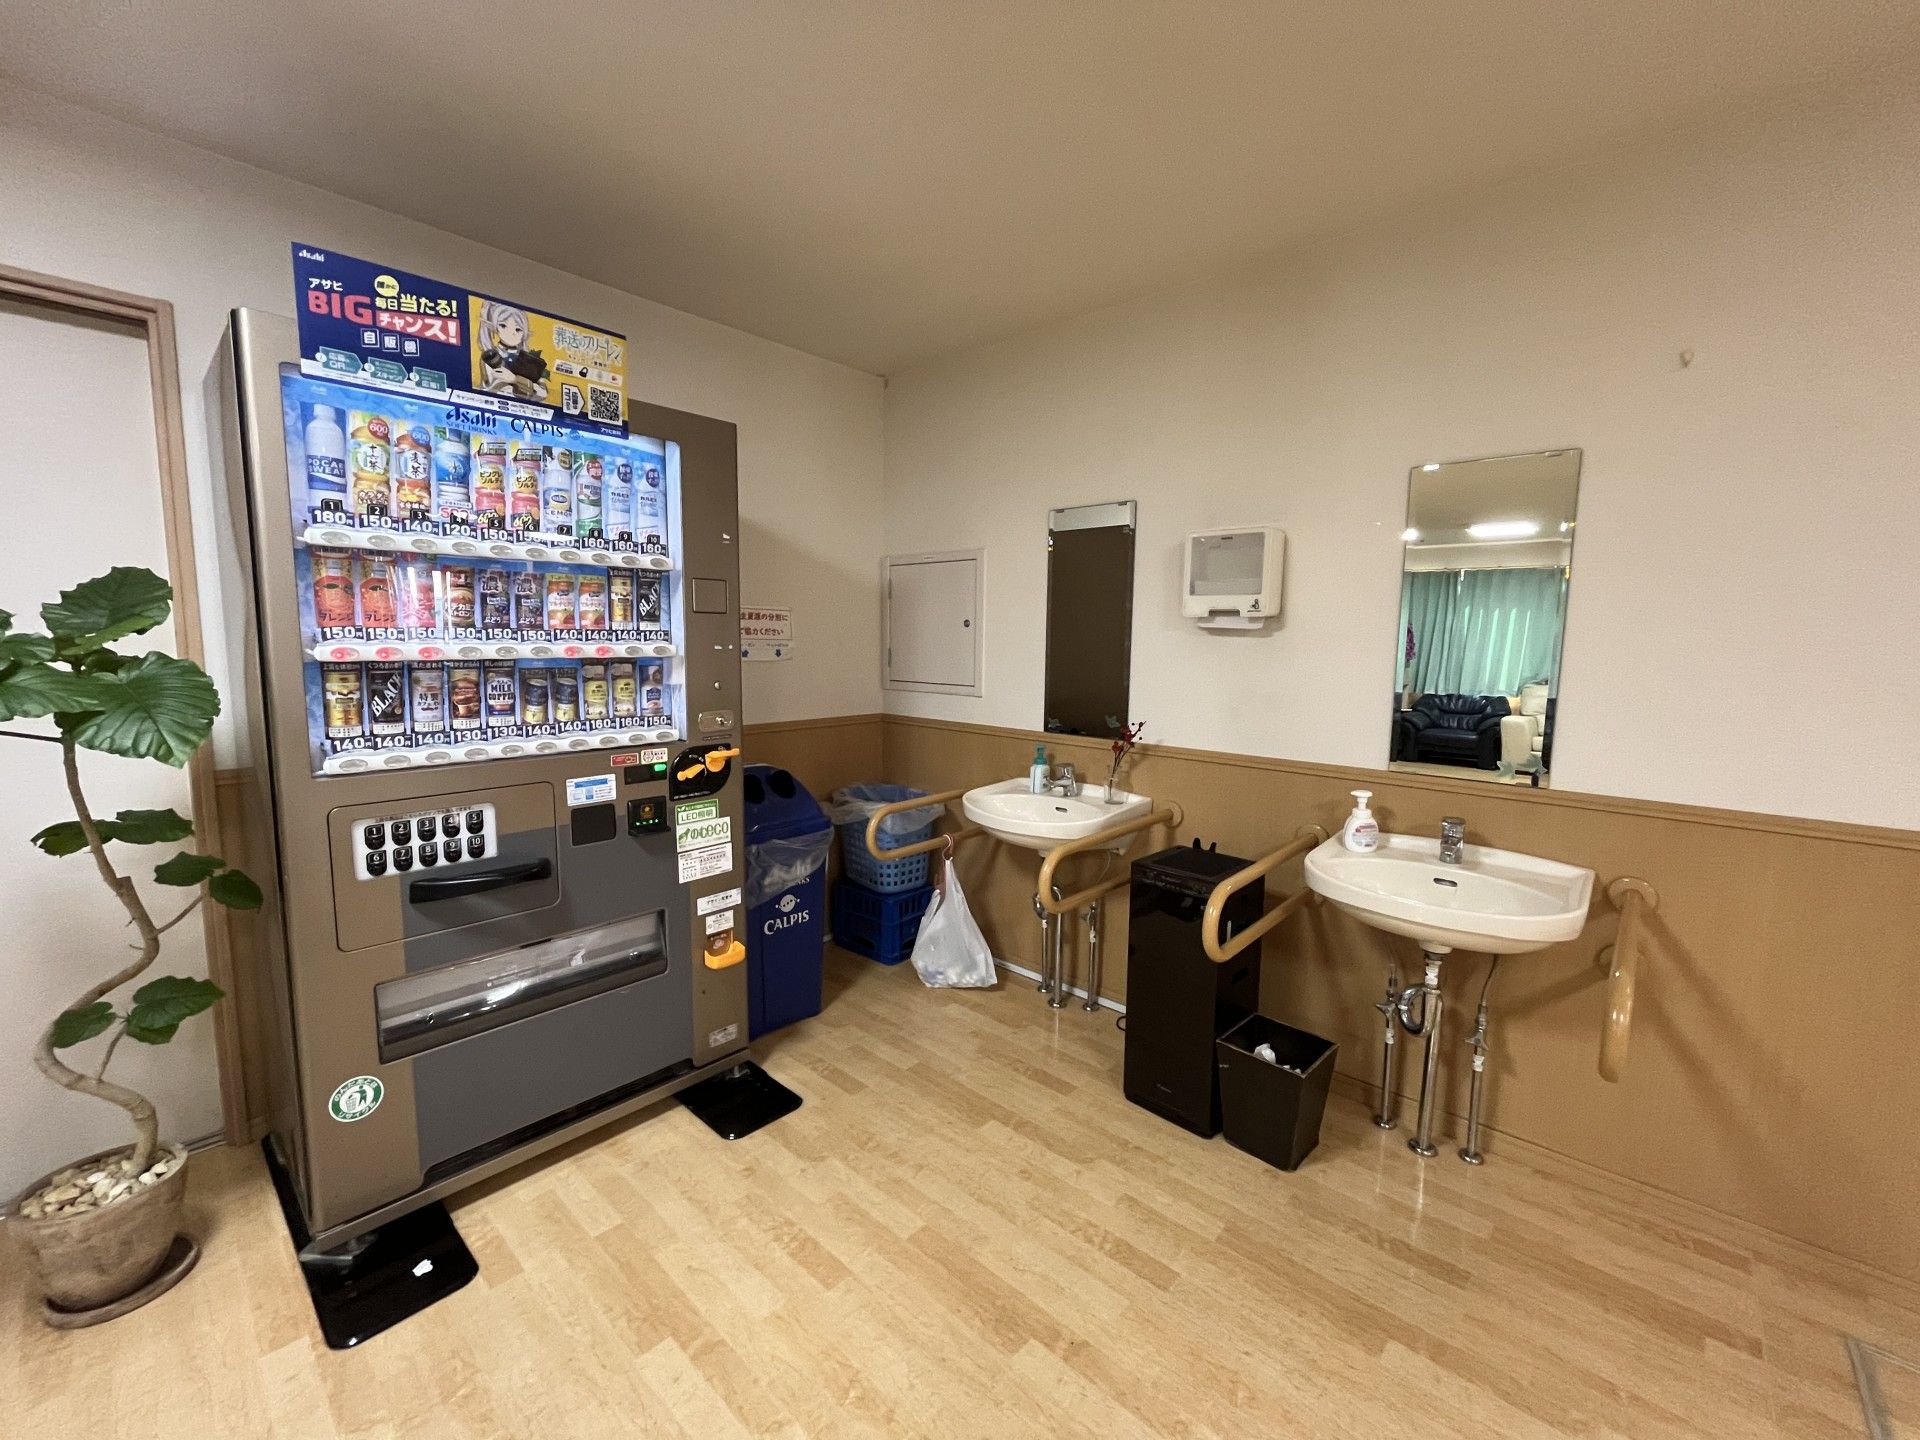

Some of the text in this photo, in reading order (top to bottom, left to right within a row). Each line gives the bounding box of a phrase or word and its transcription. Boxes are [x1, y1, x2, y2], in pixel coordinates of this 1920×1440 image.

[298, 249, 325, 262] Asahi
[308, 277, 344, 291] アサヒ
[308, 290, 373, 325] BIG
[369, 423, 389, 433] 600
[510, 418, 564, 438] CALPIS
[490, 684, 512, 692] MILK
[471, 837, 481, 845] 10
[763, 910, 810, 935] CALPIS
